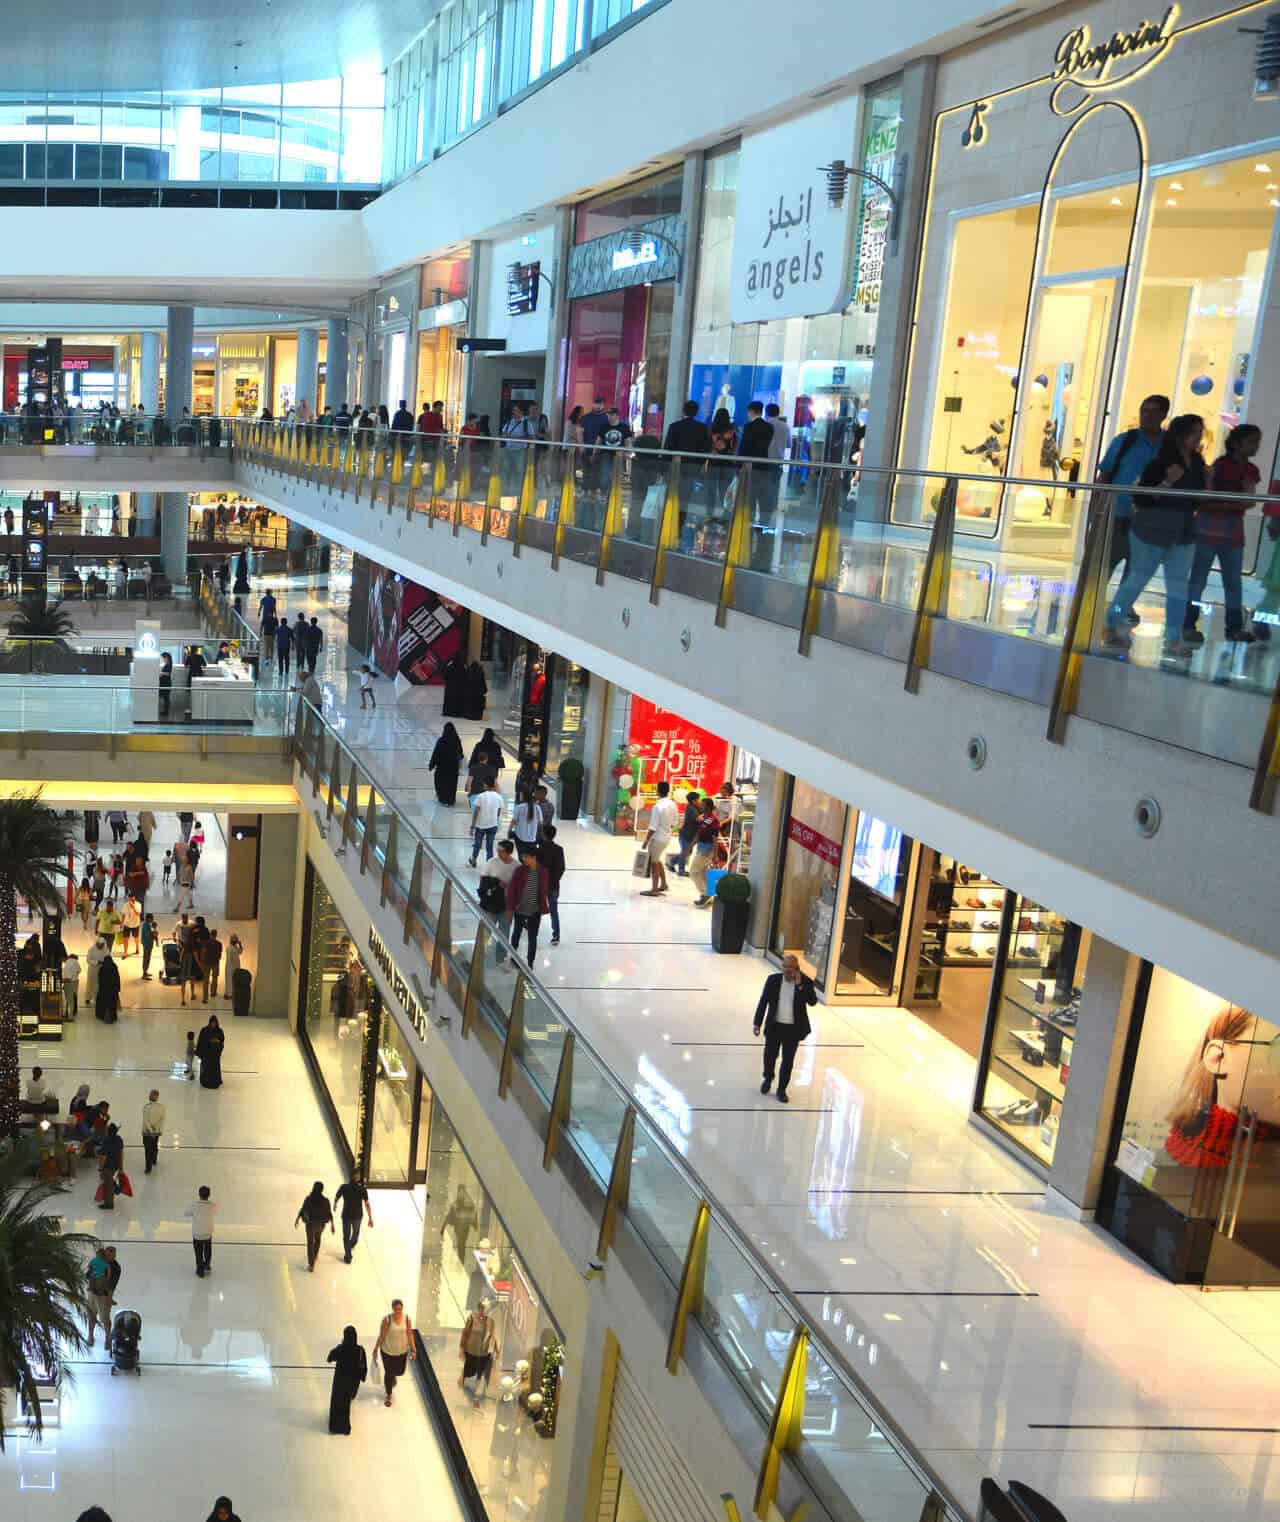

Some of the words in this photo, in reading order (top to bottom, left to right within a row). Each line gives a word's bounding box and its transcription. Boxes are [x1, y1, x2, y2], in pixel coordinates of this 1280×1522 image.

[1051, 6, 1174, 79] Bonpoint
[652, 739, 685, 773] 75
[687, 760, 705, 773] OFF
